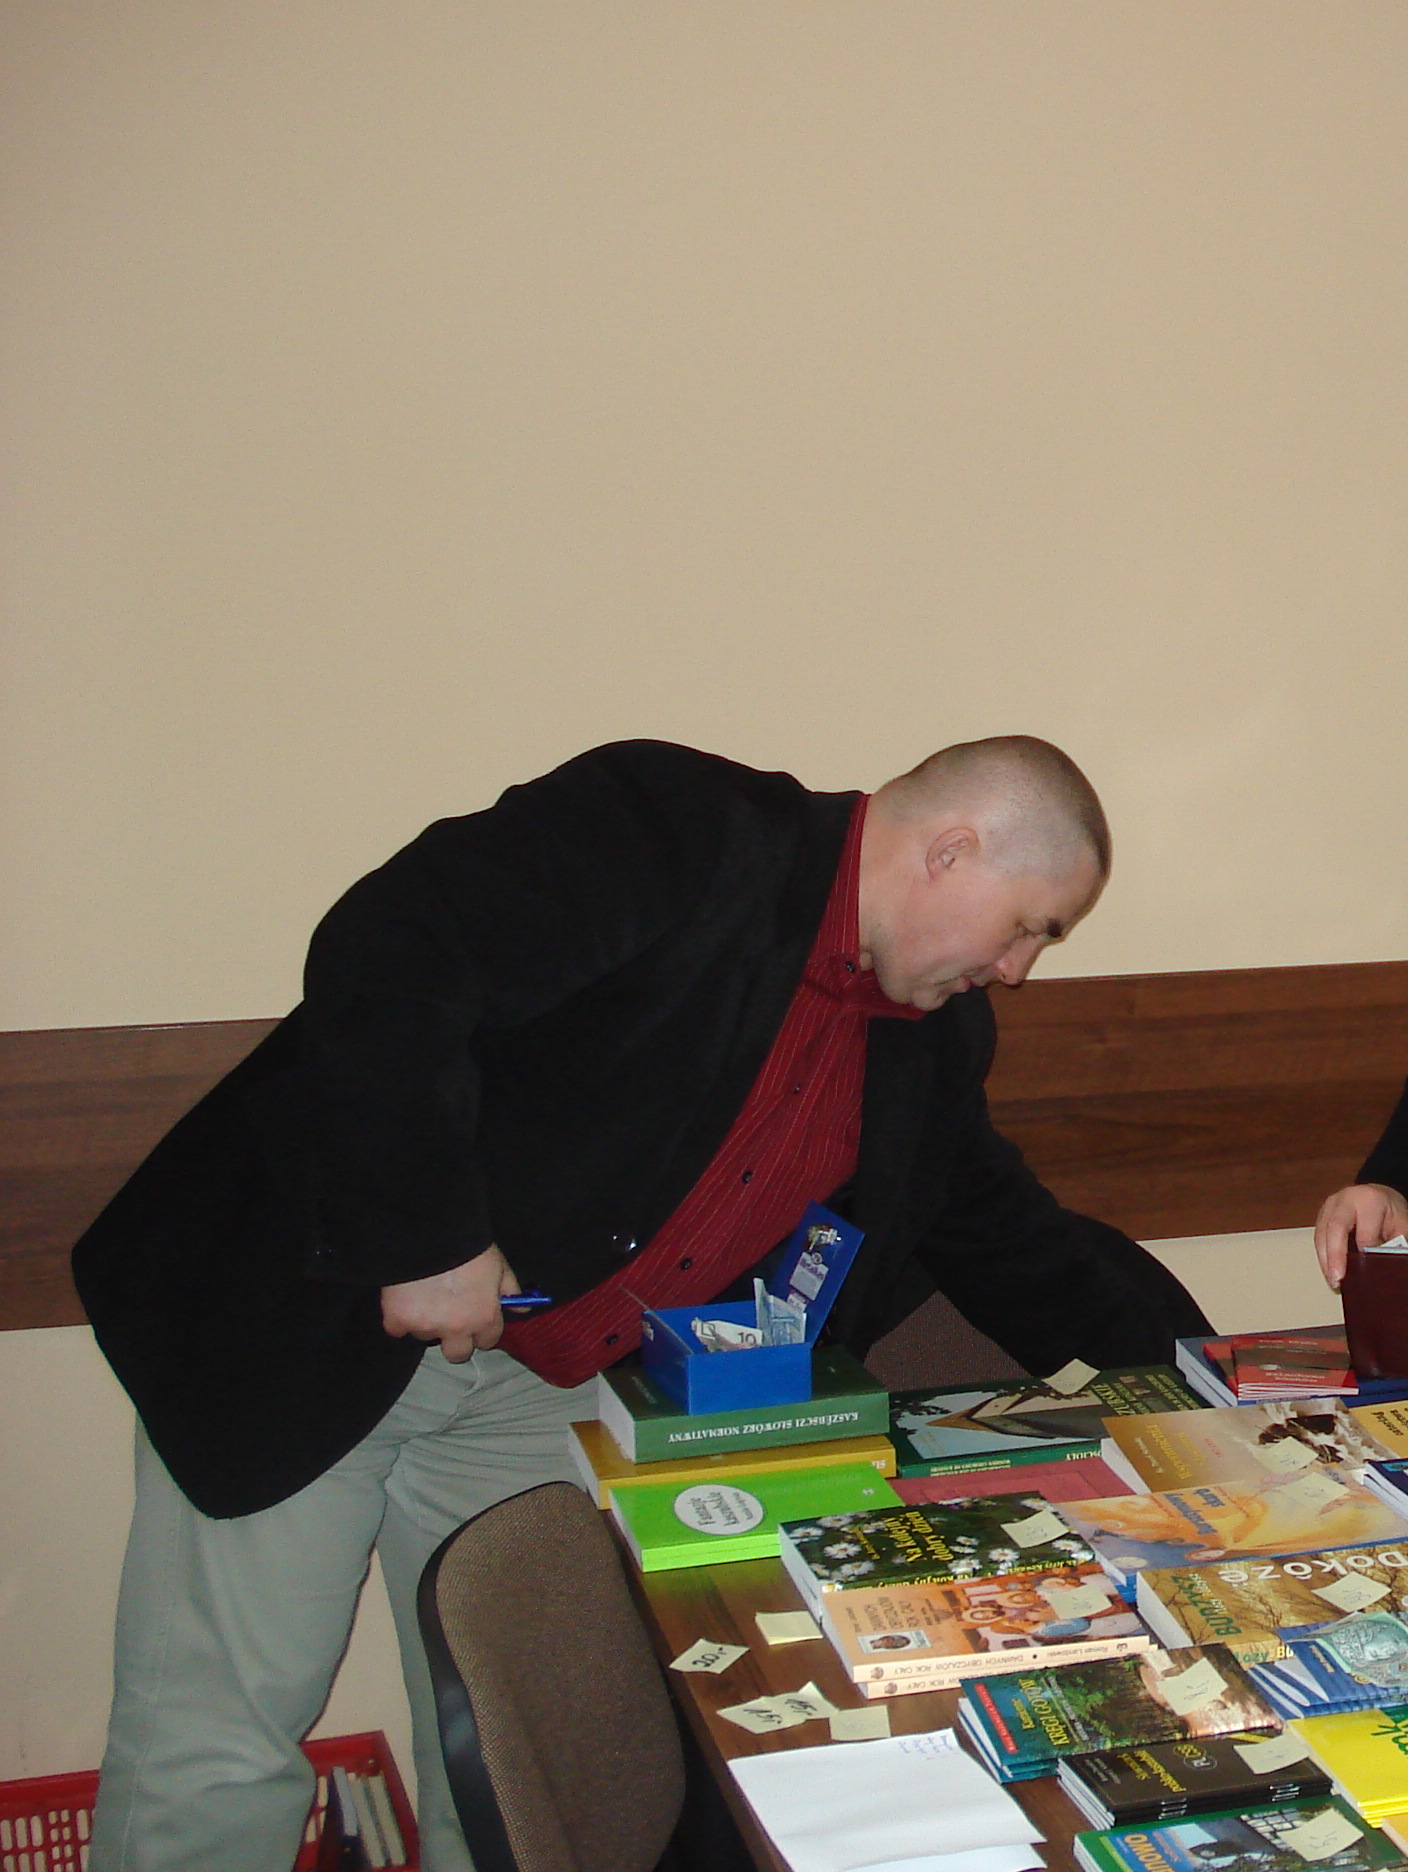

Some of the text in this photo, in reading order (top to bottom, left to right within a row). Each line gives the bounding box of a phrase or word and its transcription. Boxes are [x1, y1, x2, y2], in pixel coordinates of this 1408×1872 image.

[896, 1510, 935, 1534] dzień
[874, 1515, 929, 1562] Na kolejny
[916, 1534, 960, 1561] dobry
[894, 1667, 914, 1677] CAŁY
[916, 1664, 933, 1674] ROK
